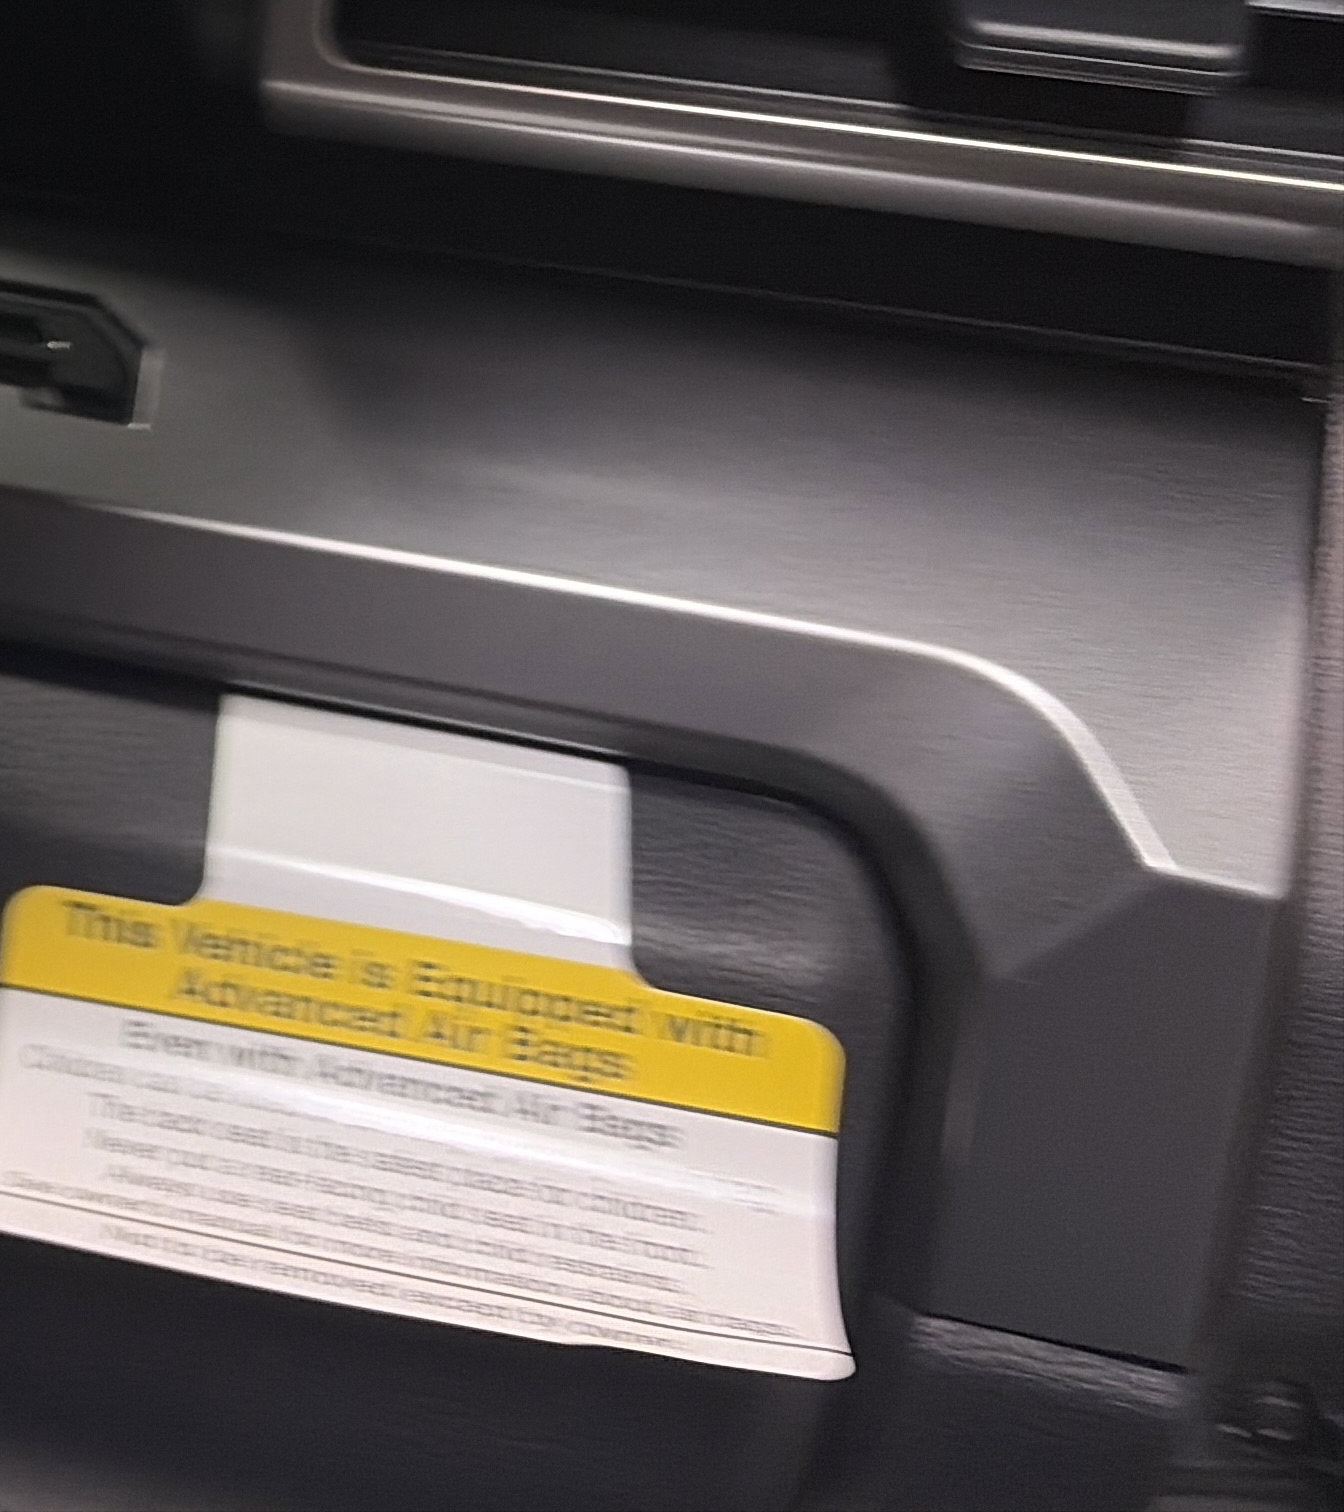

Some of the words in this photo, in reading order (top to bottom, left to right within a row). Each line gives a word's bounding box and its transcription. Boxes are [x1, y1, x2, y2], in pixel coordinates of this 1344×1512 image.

[62, 899, 160, 949] This
[168, 916, 340, 982] Vehicle
[348, 946, 394, 990] is
[408, 958, 640, 1037] Equipped
[654, 1006, 770, 1058] with
[172, 965, 404, 1044] Advanced
[418, 1008, 496, 1054] Air
[502, 1022, 638, 1084] Bags
